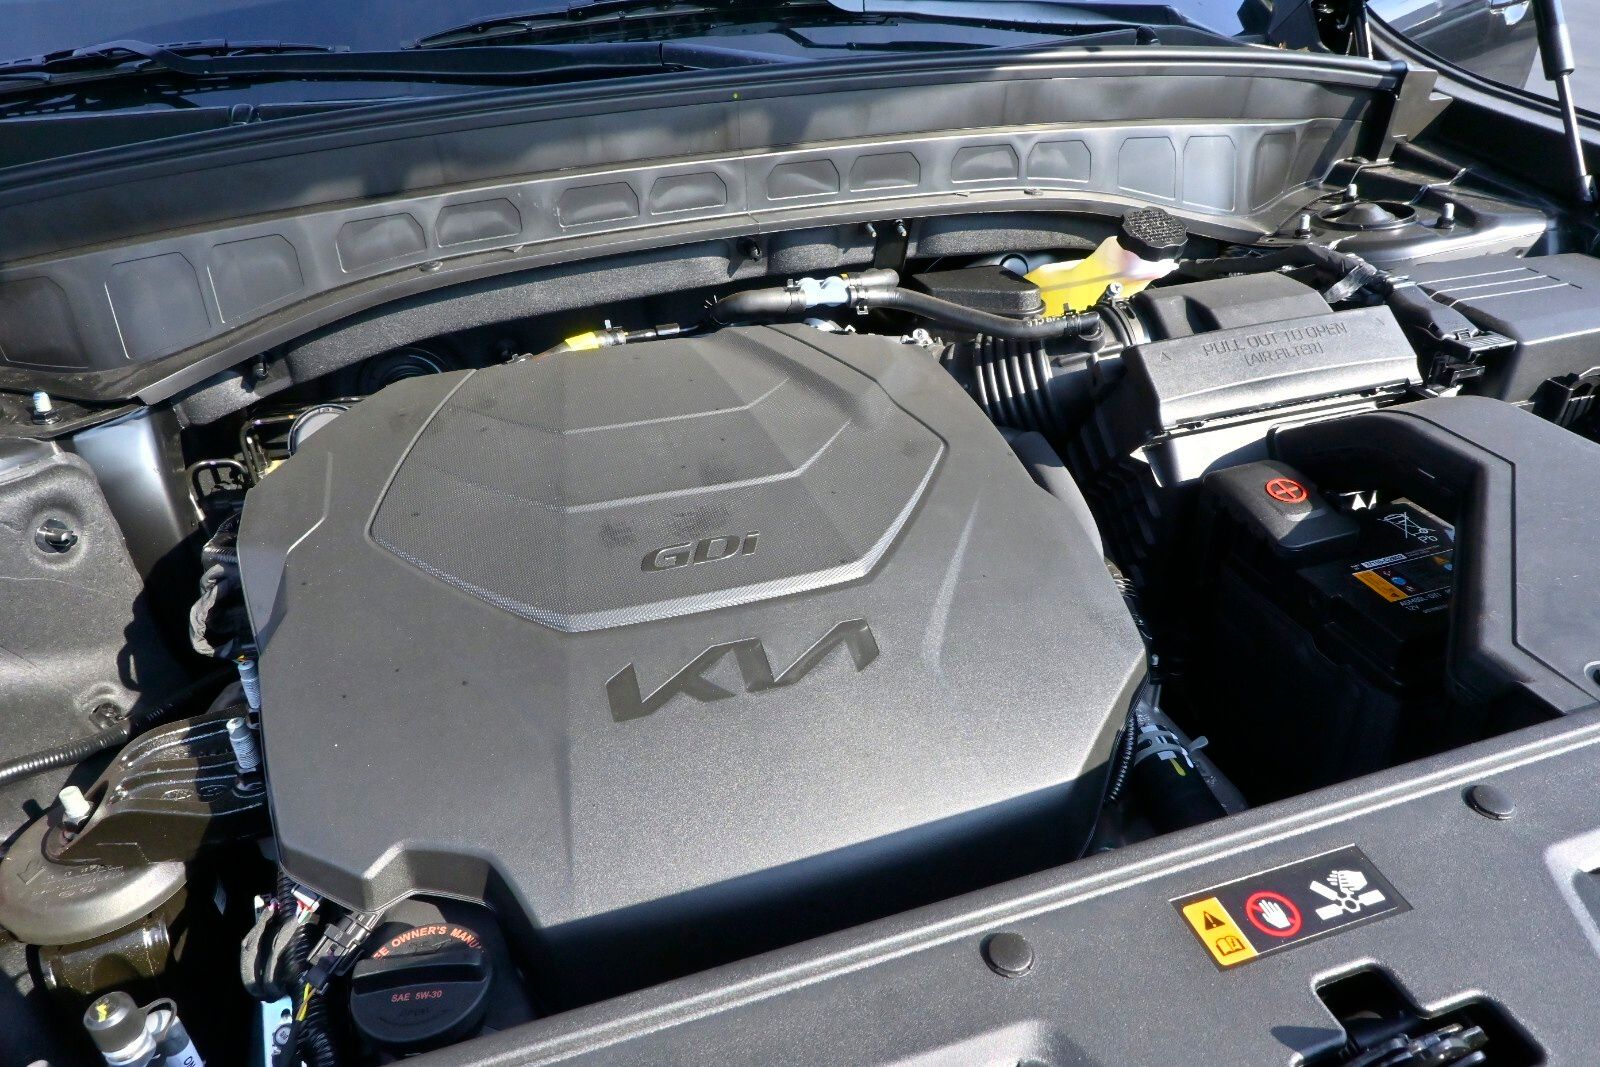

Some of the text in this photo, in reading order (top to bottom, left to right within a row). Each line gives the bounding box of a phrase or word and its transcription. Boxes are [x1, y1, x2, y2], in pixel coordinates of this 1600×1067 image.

[1203, 321, 1348, 356] PULL OUT TO OPEN
[640, 530, 760, 572] GDi
[604, 617, 880, 723] KIA
[391, 926, 447, 947] OWNER'S
[391, 990, 442, 1002] SAE 5W-30
